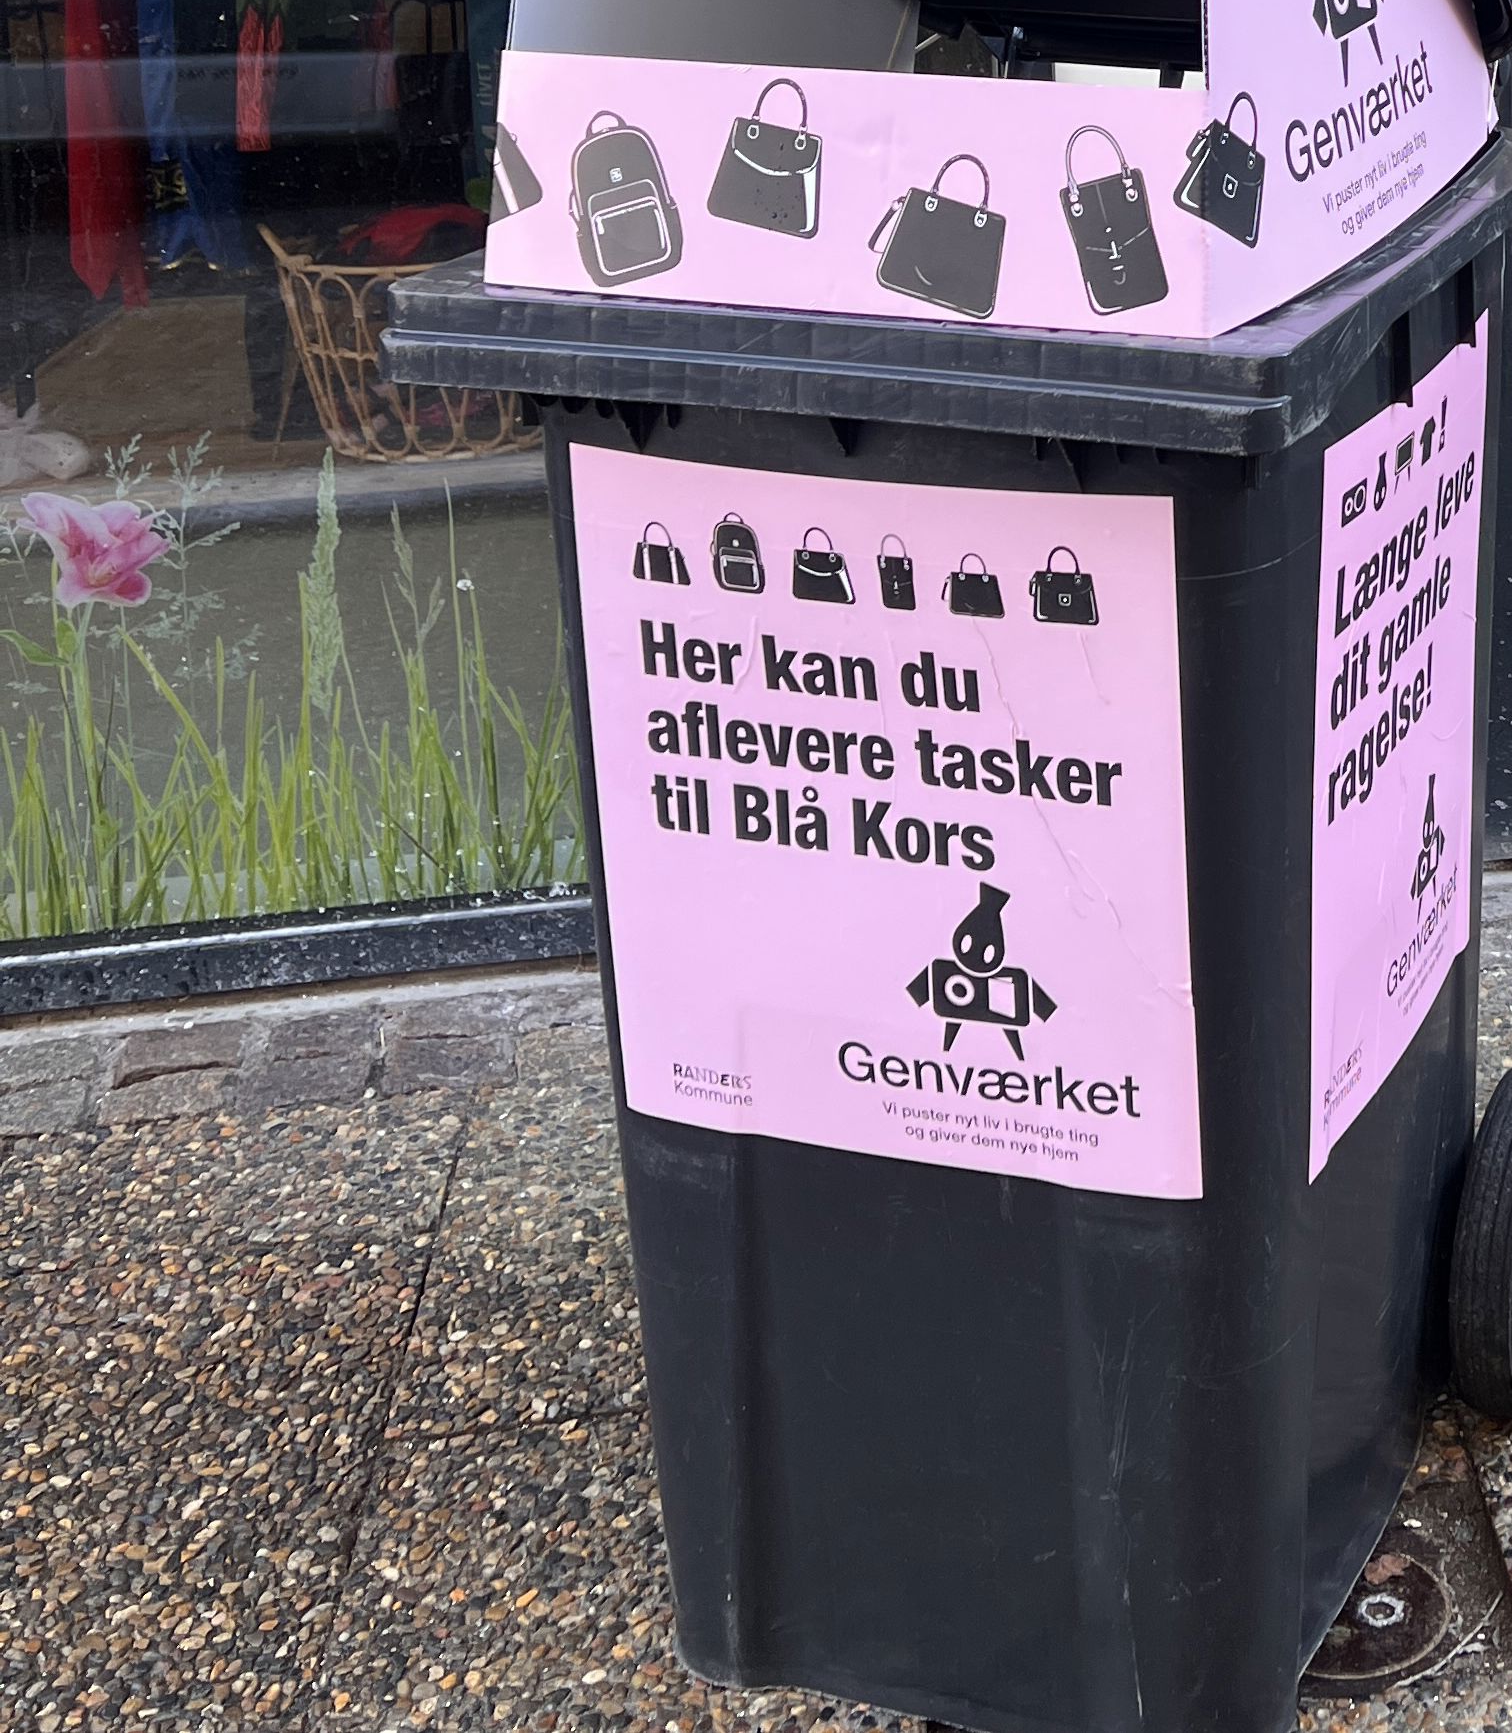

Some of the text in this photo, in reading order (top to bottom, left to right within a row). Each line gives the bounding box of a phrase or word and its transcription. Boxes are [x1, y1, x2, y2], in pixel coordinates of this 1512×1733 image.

[1285, 40, 1433, 183] Genværket
[1322, 192, 1334, 214] Vi
[1335, 177, 1363, 212] puster
[1341, 216, 1355, 235] og
[1355, 200, 1376, 230] giver
[1333, 450, 1475, 640] Længe leve
[637, 618, 981, 713] Her kan du
[1329, 553, 1452, 732] dit gamle
[646, 700, 1124, 808] aflevere tasker
[1326, 641, 1434, 828] ragelse!
[650, 772, 996, 872] til Blå Kors
[1386, 861, 1458, 997] Genværket
[673, 1063, 752, 1090] RANDERS
[674, 1079, 753, 1107] Kommune
[837, 1040, 1141, 1119] Genværket
[881, 1101, 897, 1116] Vi
[902, 1105, 950, 1124] puster
[955, 1112, 980, 1130] nyt
[983, 1115, 1000, 1130] liv
[1014, 1119, 1065, 1141] brugte
[1068, 1127, 1099, 1147] ting
[904, 1124, 1079, 1162] og giver dem nye hjem
